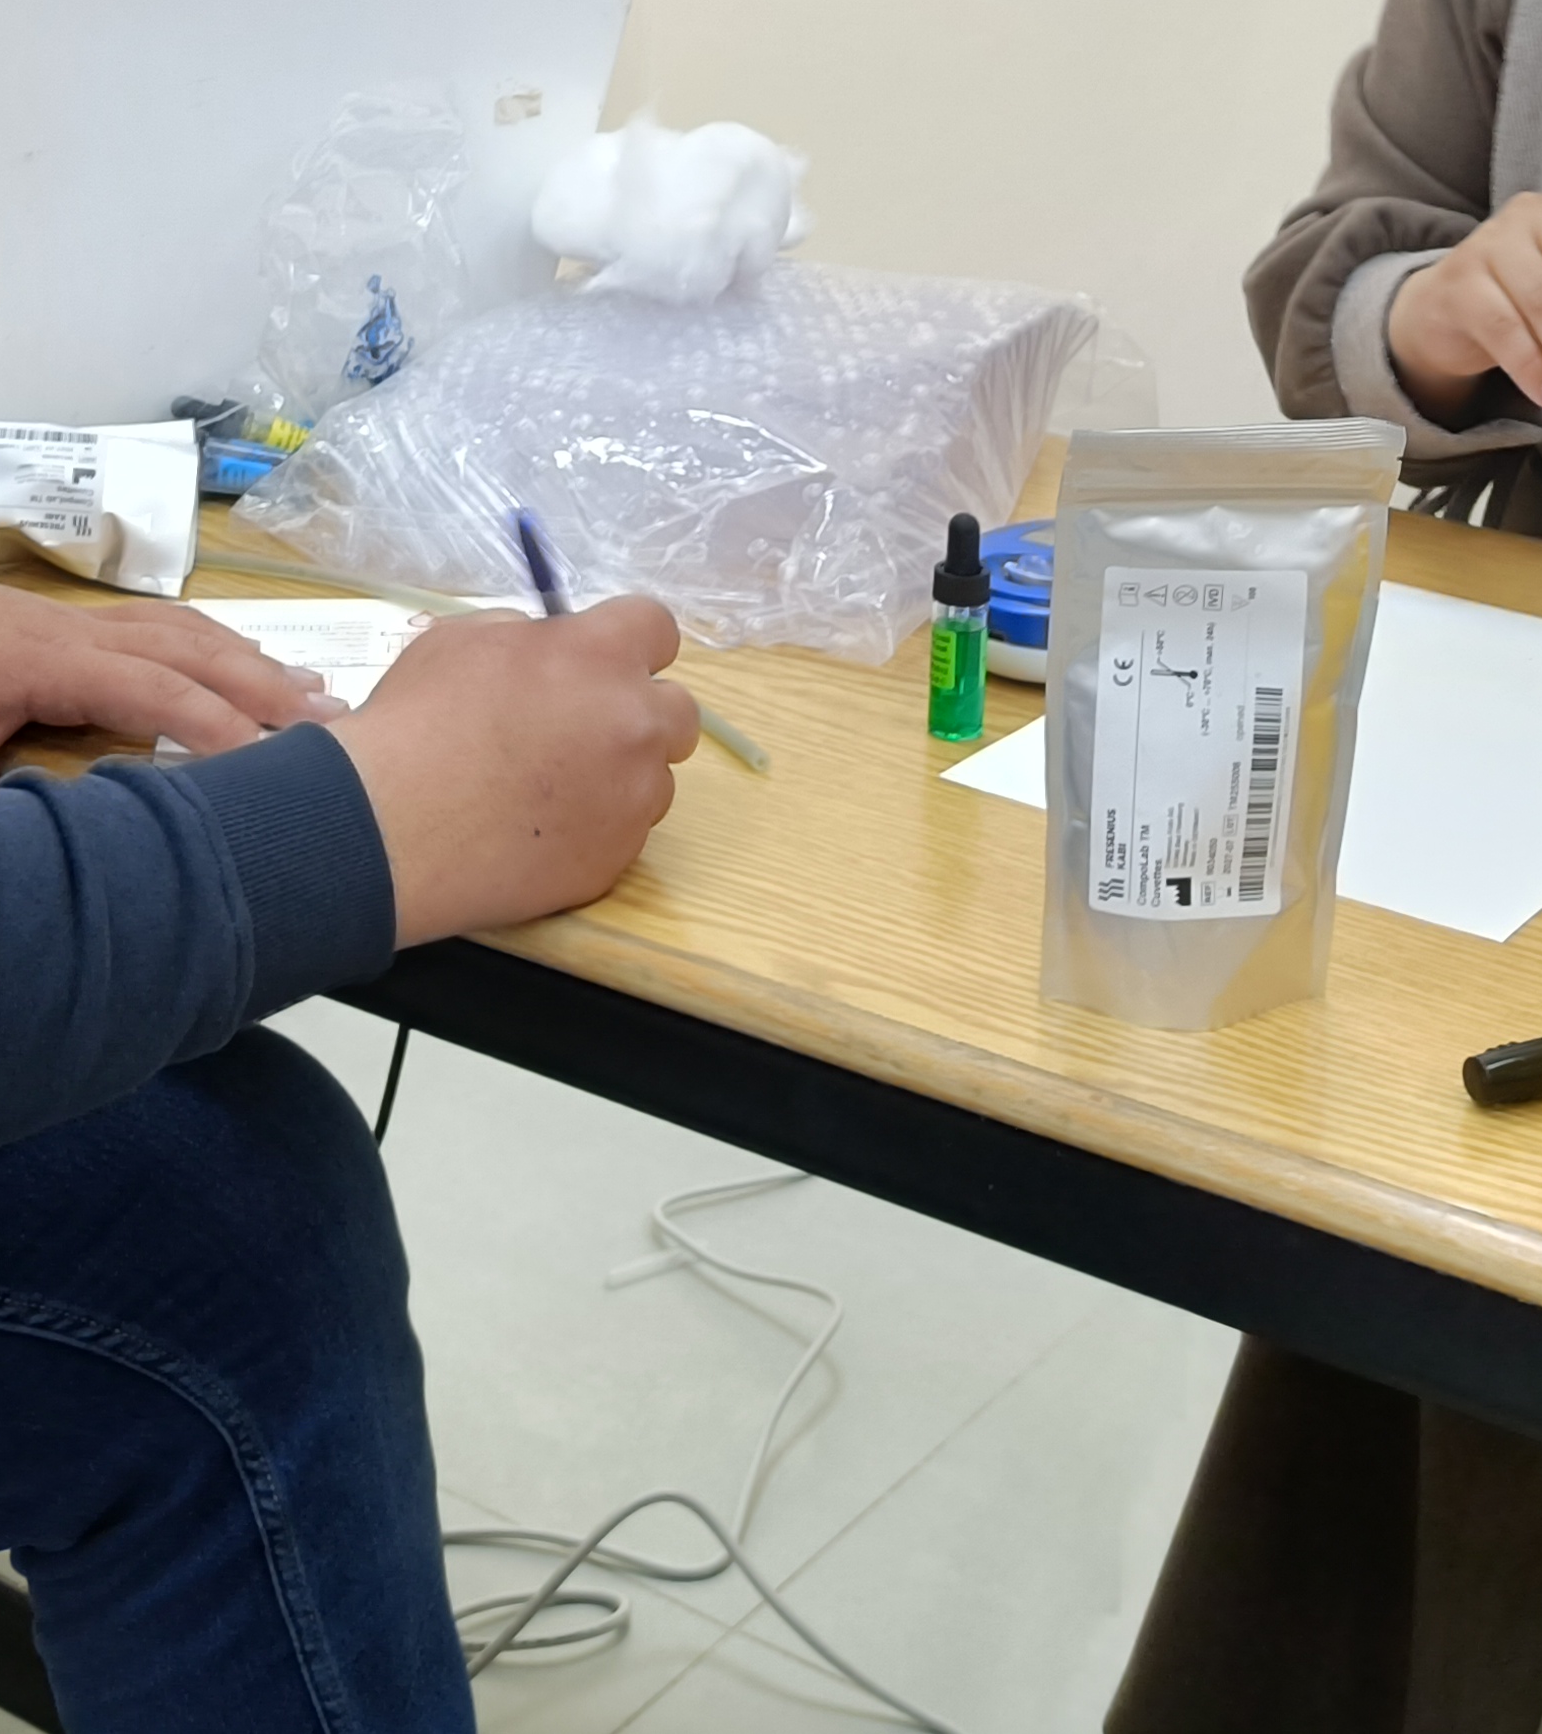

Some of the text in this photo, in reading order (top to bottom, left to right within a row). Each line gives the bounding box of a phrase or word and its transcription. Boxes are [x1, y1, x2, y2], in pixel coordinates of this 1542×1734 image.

[1208, 589, 1219, 607] IVD
[1105, 809, 1116, 869] FRESENIUS
[1117, 843, 1126, 870] KABI
[1137, 825, 1150, 906] CompoLab TM
[1151, 859, 1162, 907] Cuvettes
